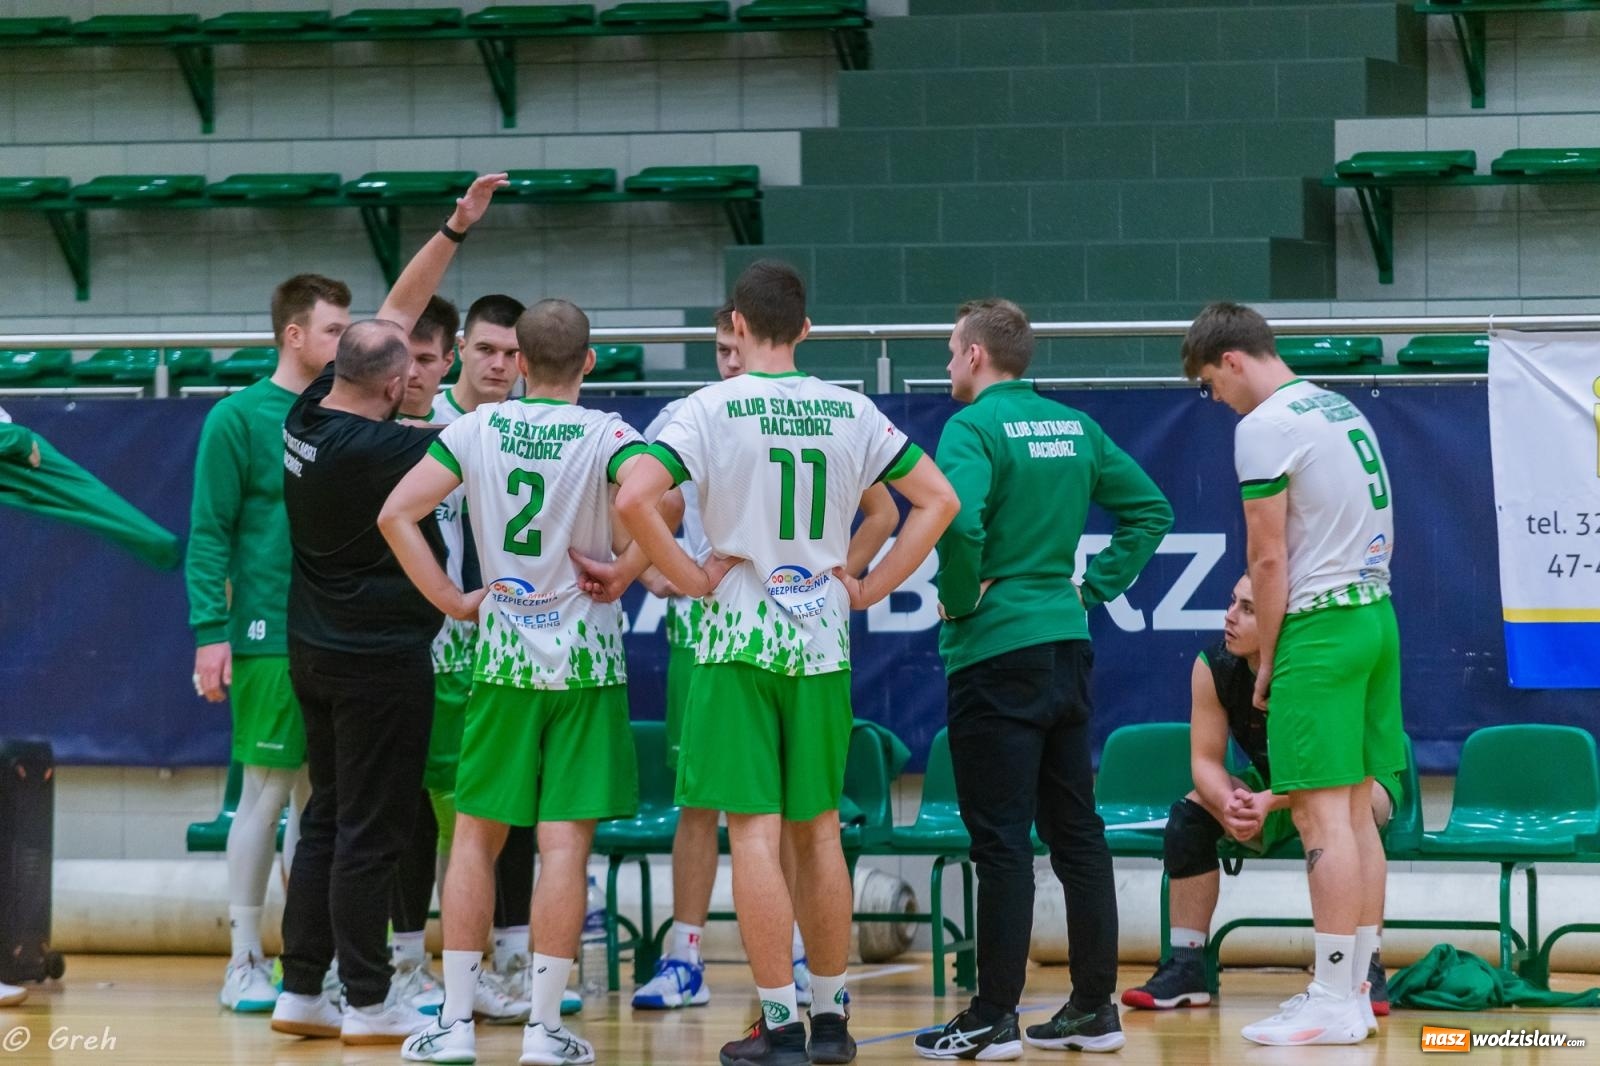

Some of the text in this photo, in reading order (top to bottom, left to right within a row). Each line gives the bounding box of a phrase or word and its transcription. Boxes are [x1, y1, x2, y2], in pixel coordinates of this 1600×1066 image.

[727, 397, 855, 419] KLUB SIATKARSKI
[760, 416, 833, 436] RACIBÓRZ
[1003, 421, 1032, 438] KLUB
[1028, 438, 1077, 458] RACIBÓRZ
[1347, 428, 1389, 510] 9
[769, 447, 827, 540] 11
[504, 468, 545, 556] 2
[1526, 510, 1567, 535] tel.
[247, 619, 266, 640] 49
